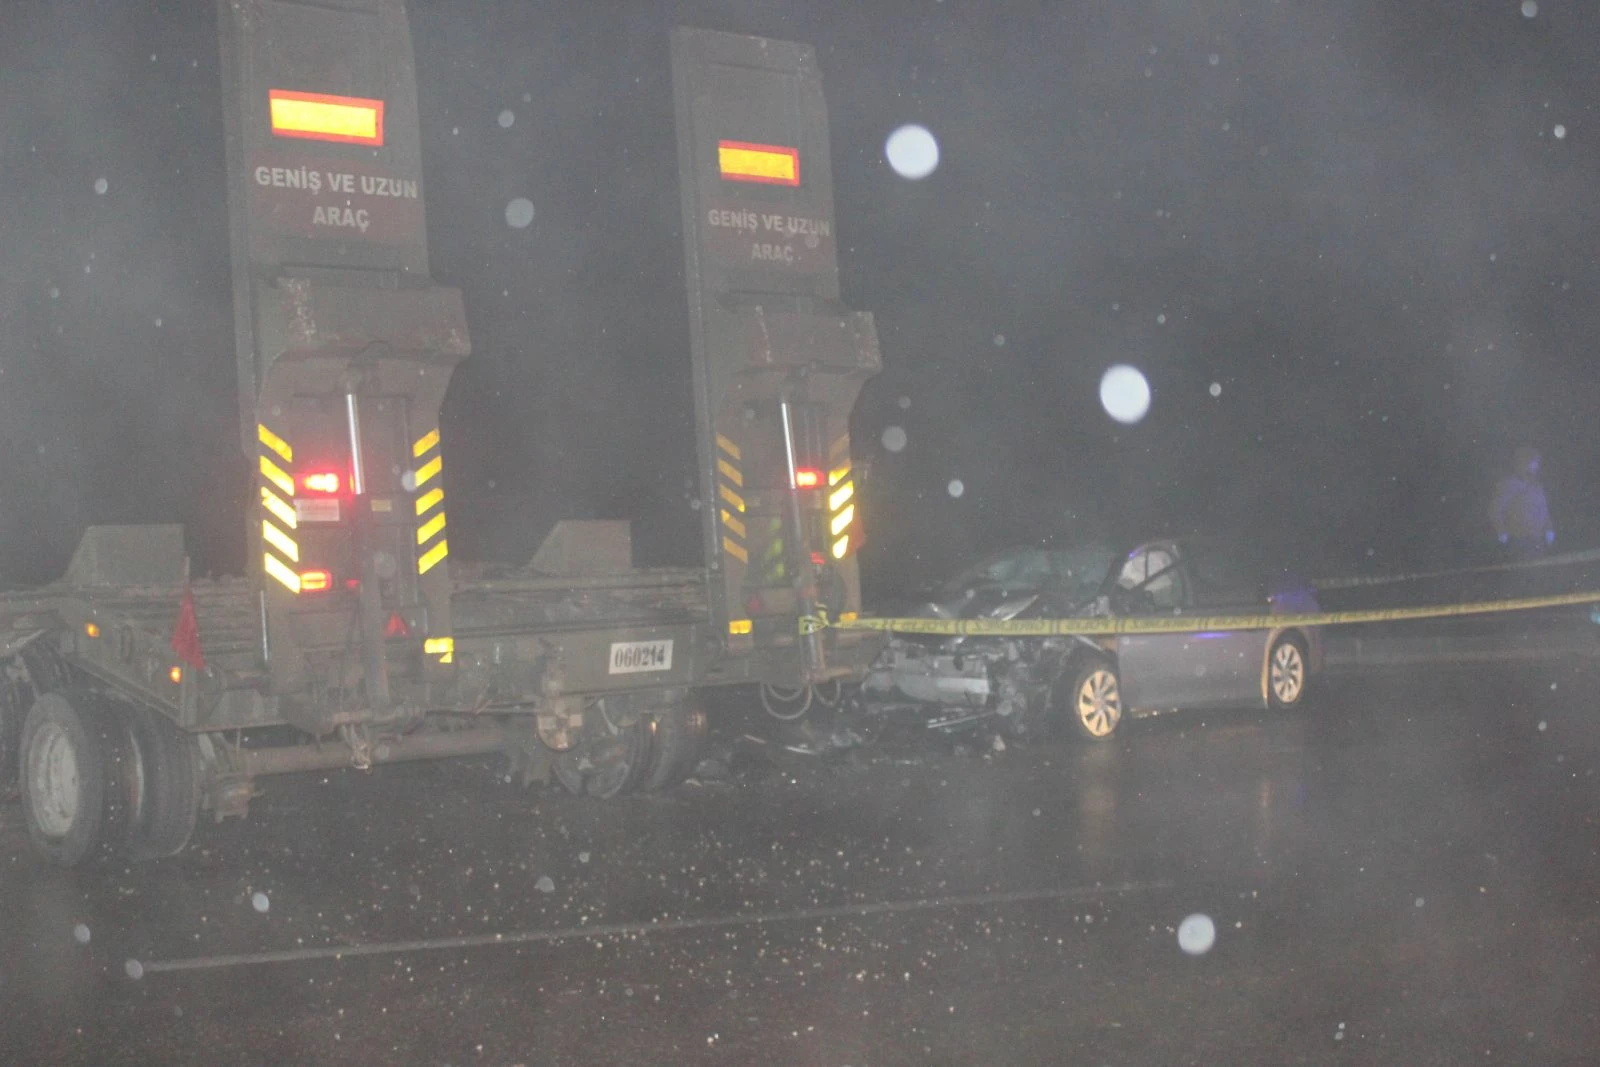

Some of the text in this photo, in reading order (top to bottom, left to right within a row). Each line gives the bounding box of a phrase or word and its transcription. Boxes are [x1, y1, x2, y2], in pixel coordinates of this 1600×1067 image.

[255, 165, 417, 198] GENİŞ VE UZUN
[312, 205, 370, 233] ARAÇ
[708, 208, 830, 236] GENİŞ VE UZUN
[751, 242, 794, 266] ARAÇ
[614, 645, 665, 668] 060214
